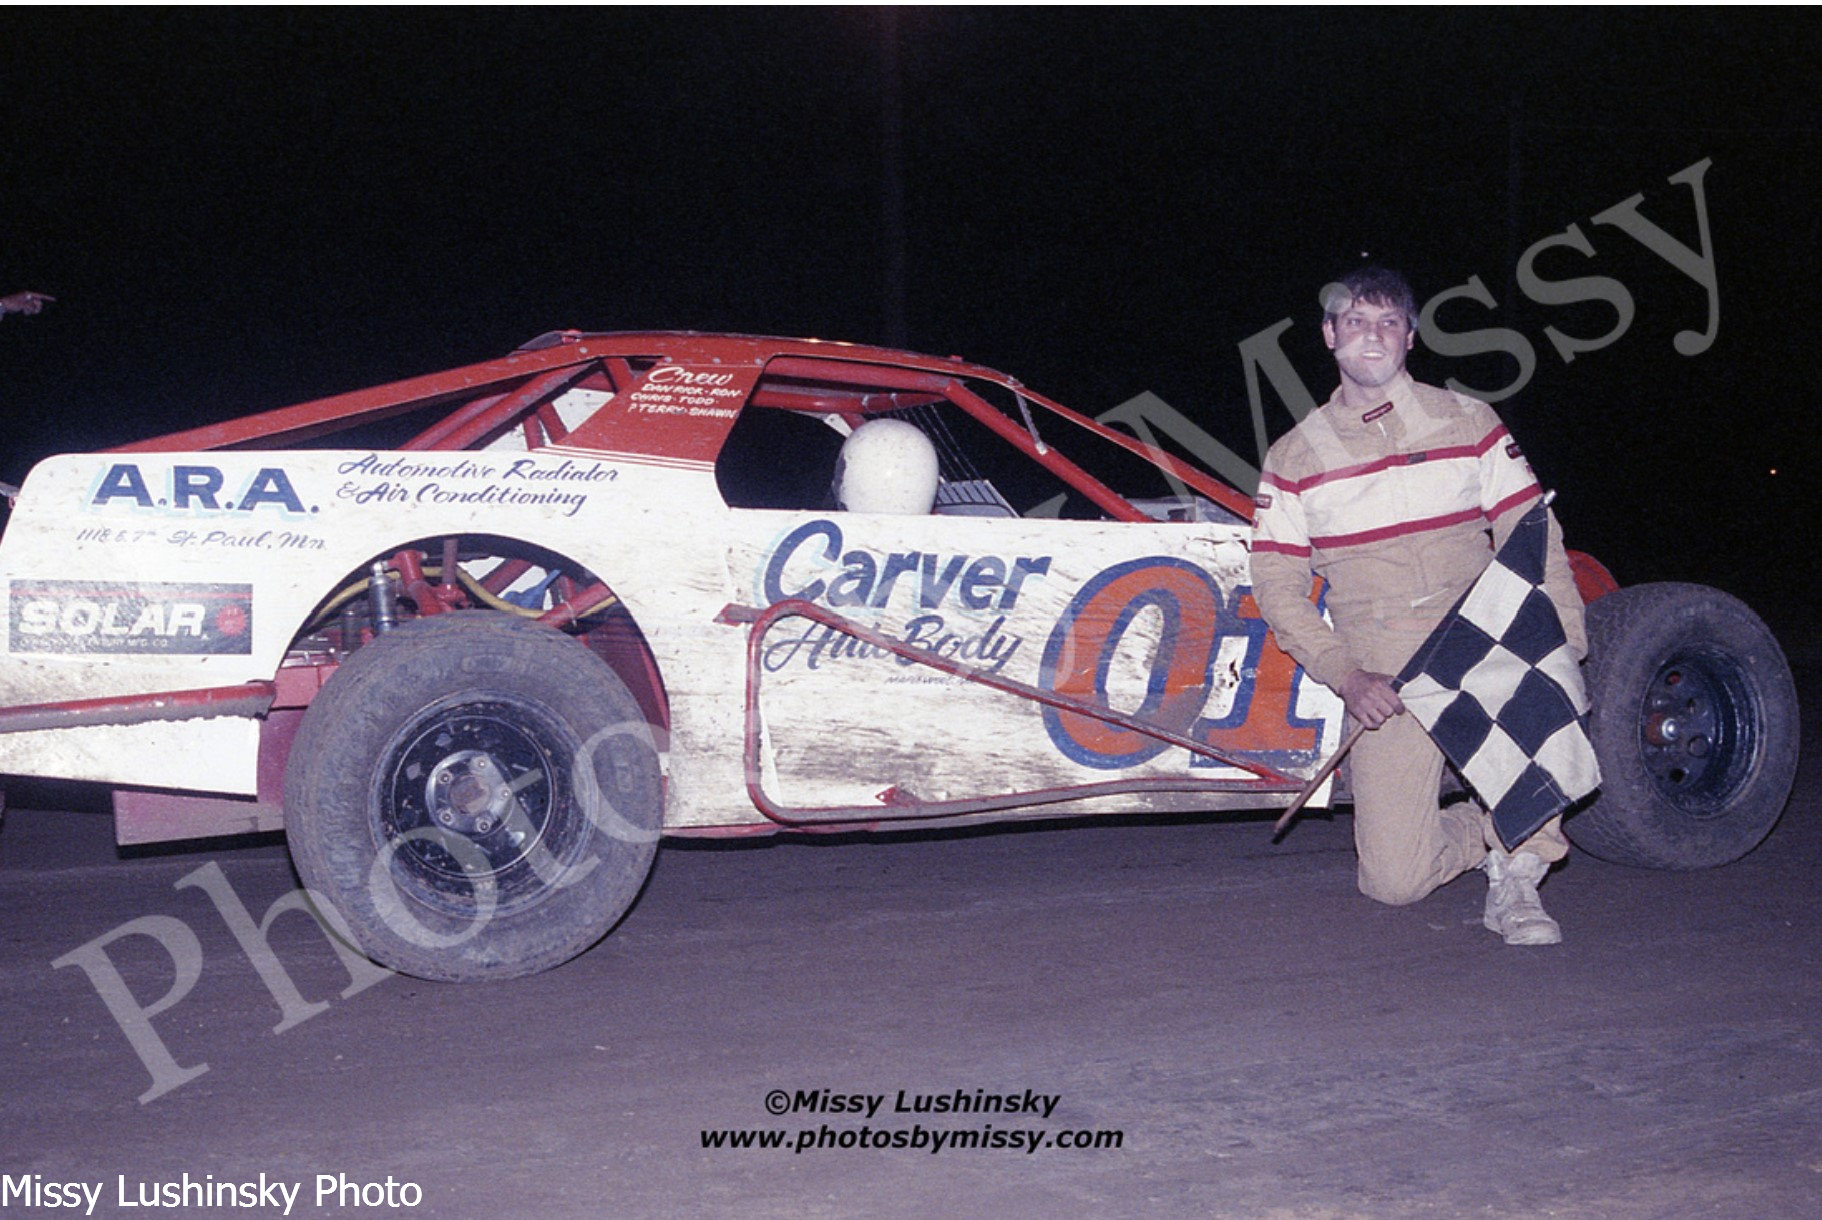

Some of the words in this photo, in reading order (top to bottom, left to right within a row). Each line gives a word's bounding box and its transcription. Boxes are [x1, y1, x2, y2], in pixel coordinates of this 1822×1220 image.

[649, 367, 733, 384] Crew
[337, 453, 496, 477] Automotive
[502, 458, 619, 482] Radiator
[416, 483, 587, 517] Conditioning
[763, 518, 1052, 612] Carver
[18, 600, 206, 637] SOLAR
[895, 614, 1023, 675] Body
